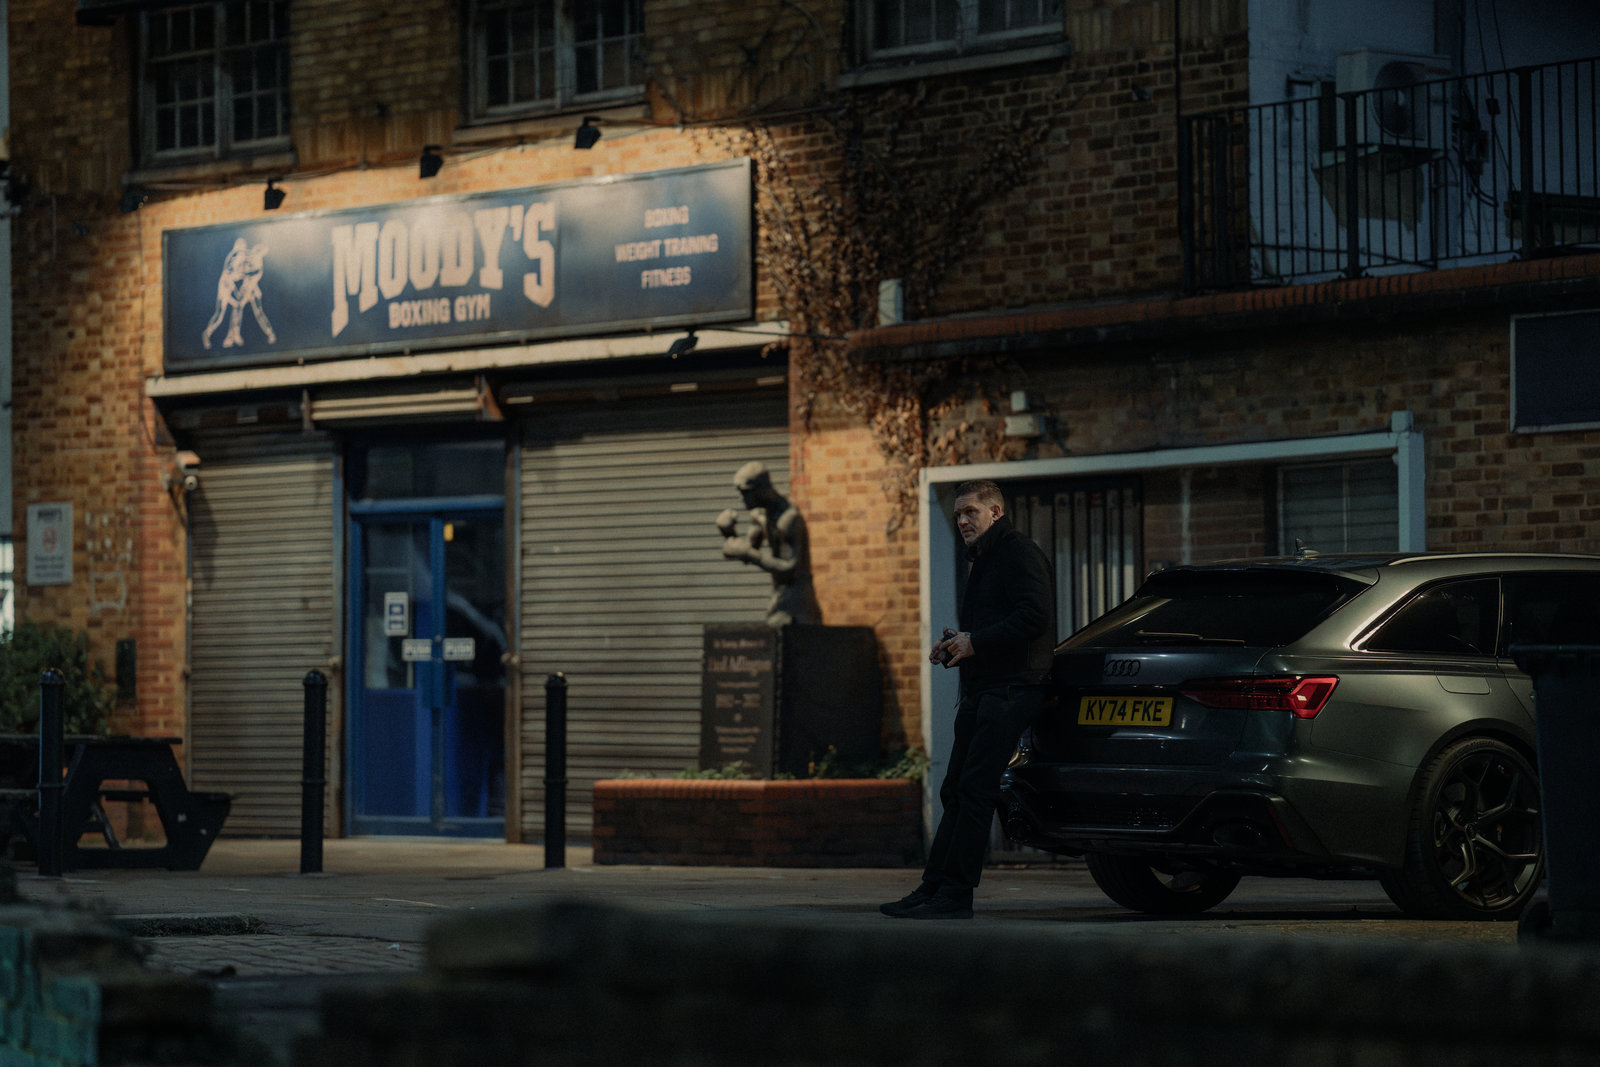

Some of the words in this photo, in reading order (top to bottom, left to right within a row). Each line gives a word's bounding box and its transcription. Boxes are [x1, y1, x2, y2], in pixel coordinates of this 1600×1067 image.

[645, 205, 689, 228] BOXING
[615, 239, 661, 262] WEIGHT
[663, 233, 719, 257] TRAINING
[331, 202, 555, 338] MOODY'S
[641, 266, 691, 289] FITNESS
[389, 297, 450, 329] BOXING
[455, 294, 491, 322] GYM
[1086, 700, 1127, 721] KY74
[1131, 700, 1165, 722] FKE
